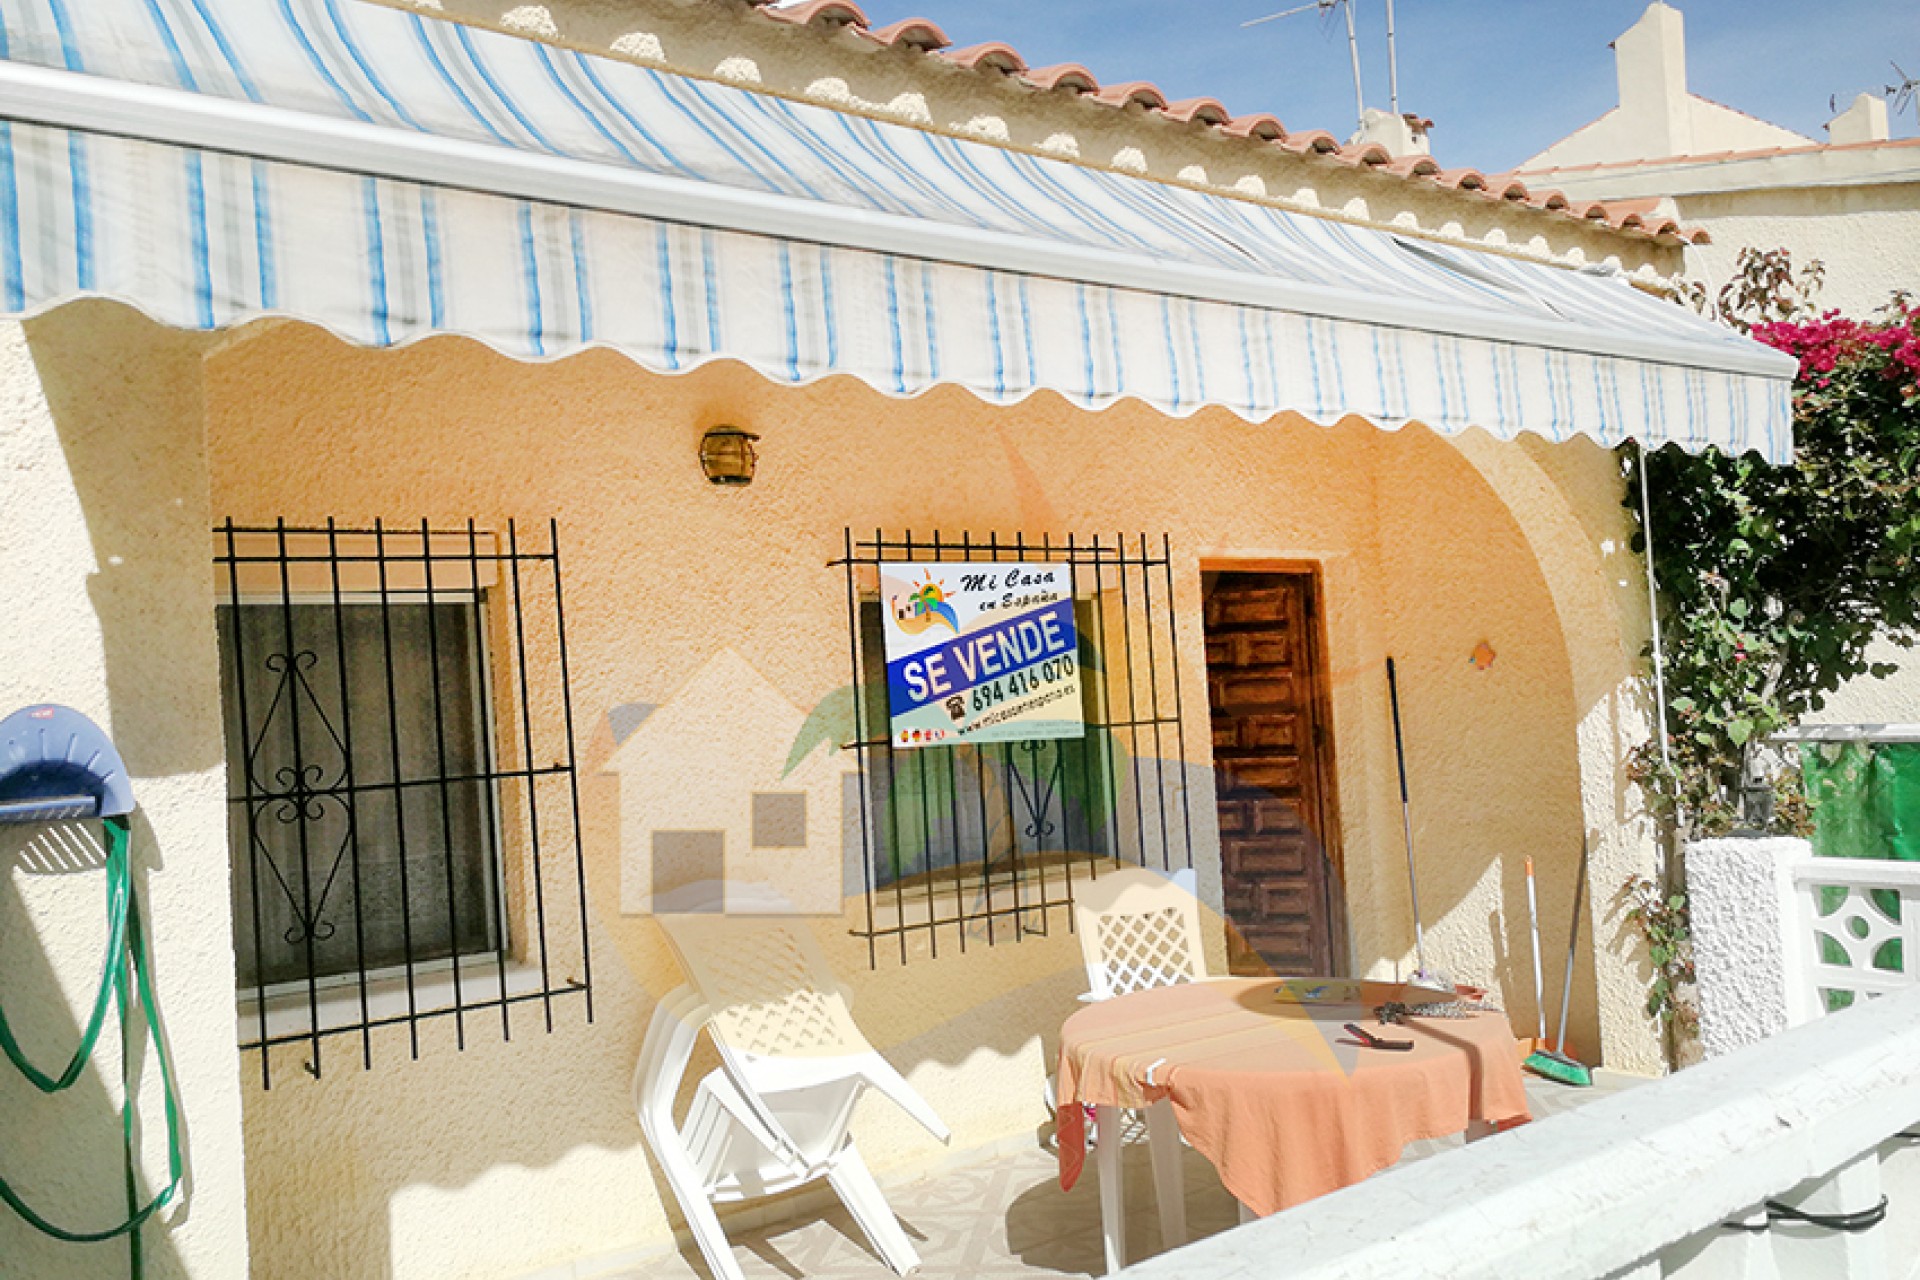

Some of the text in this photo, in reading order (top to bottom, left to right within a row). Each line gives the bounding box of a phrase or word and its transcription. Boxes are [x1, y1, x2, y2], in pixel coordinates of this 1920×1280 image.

[960, 568, 1055, 592] Mi Casa
[979, 589, 1058, 611] en España
[903, 611, 1065, 702] SE VENDE
[973, 654, 1074, 711] 694 416 070
